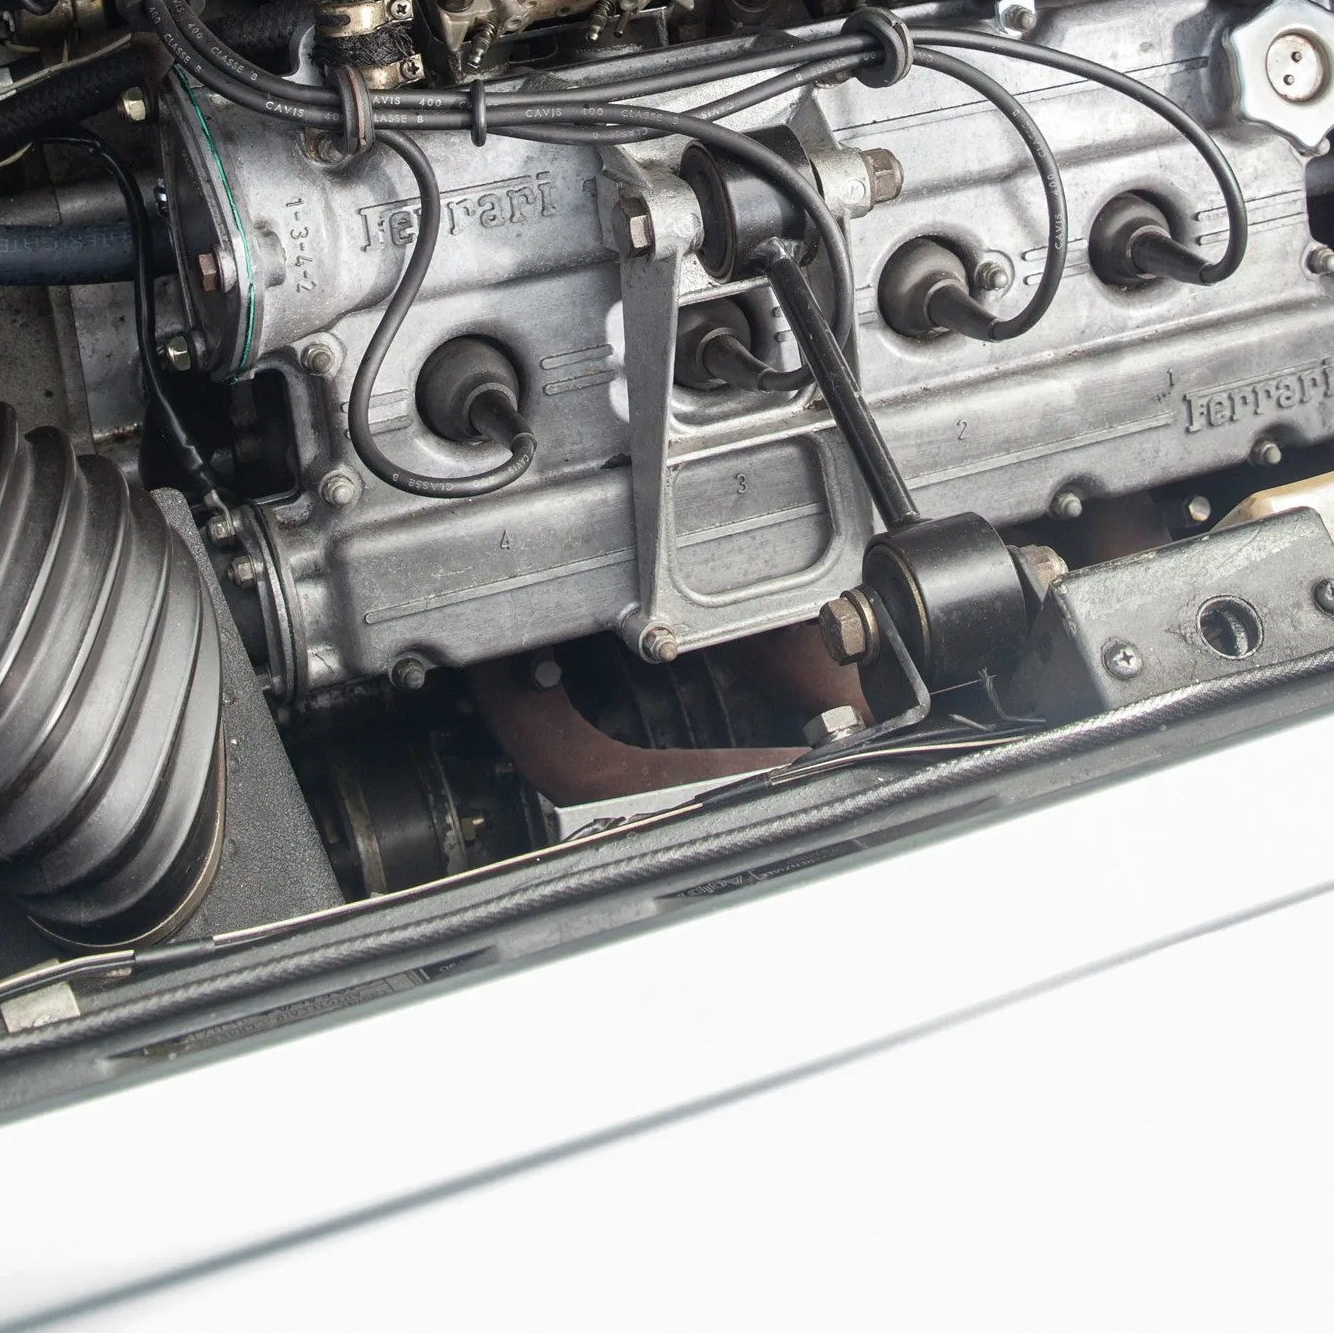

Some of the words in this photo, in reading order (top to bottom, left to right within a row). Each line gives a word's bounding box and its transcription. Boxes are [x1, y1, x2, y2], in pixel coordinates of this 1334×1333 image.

[149, 6, 161, 24] 400
[163, 33, 191, 61] CLASSE
[194, 64, 202, 74] B
[188, 22, 203, 40] 400
[211, 46, 243, 74] CLASSE
[251, 71, 258, 81] B
[265, 100, 305, 118] CAVIS
[324, 112, 340, 121] 40
[373, 95, 401, 106] AVIS
[419, 97, 442, 108] 400
[700, 102, 735, 120] CAVIS
[373, 114, 407, 124] LASSE
[417, 114, 424, 124] B
[525, 108, 562, 119] CAVIS
[582, 107, 604, 117] 400
[621, 108, 663, 123] CLASSE
[1047, 174, 1058, 195] 400
[358, 171, 557, 253] Ferari
[1054, 214, 1063, 250] CAVIS
[1183, 356, 1334, 433] Ferrari
[956, 420, 969, 440] 2
[508, 455, 530, 474] CAVIS
[392, 473, 399, 481] B
[408, 478, 454, 491] CLASSE
[734, 473, 748, 495] 3
[499, 529, 511, 551] 4
